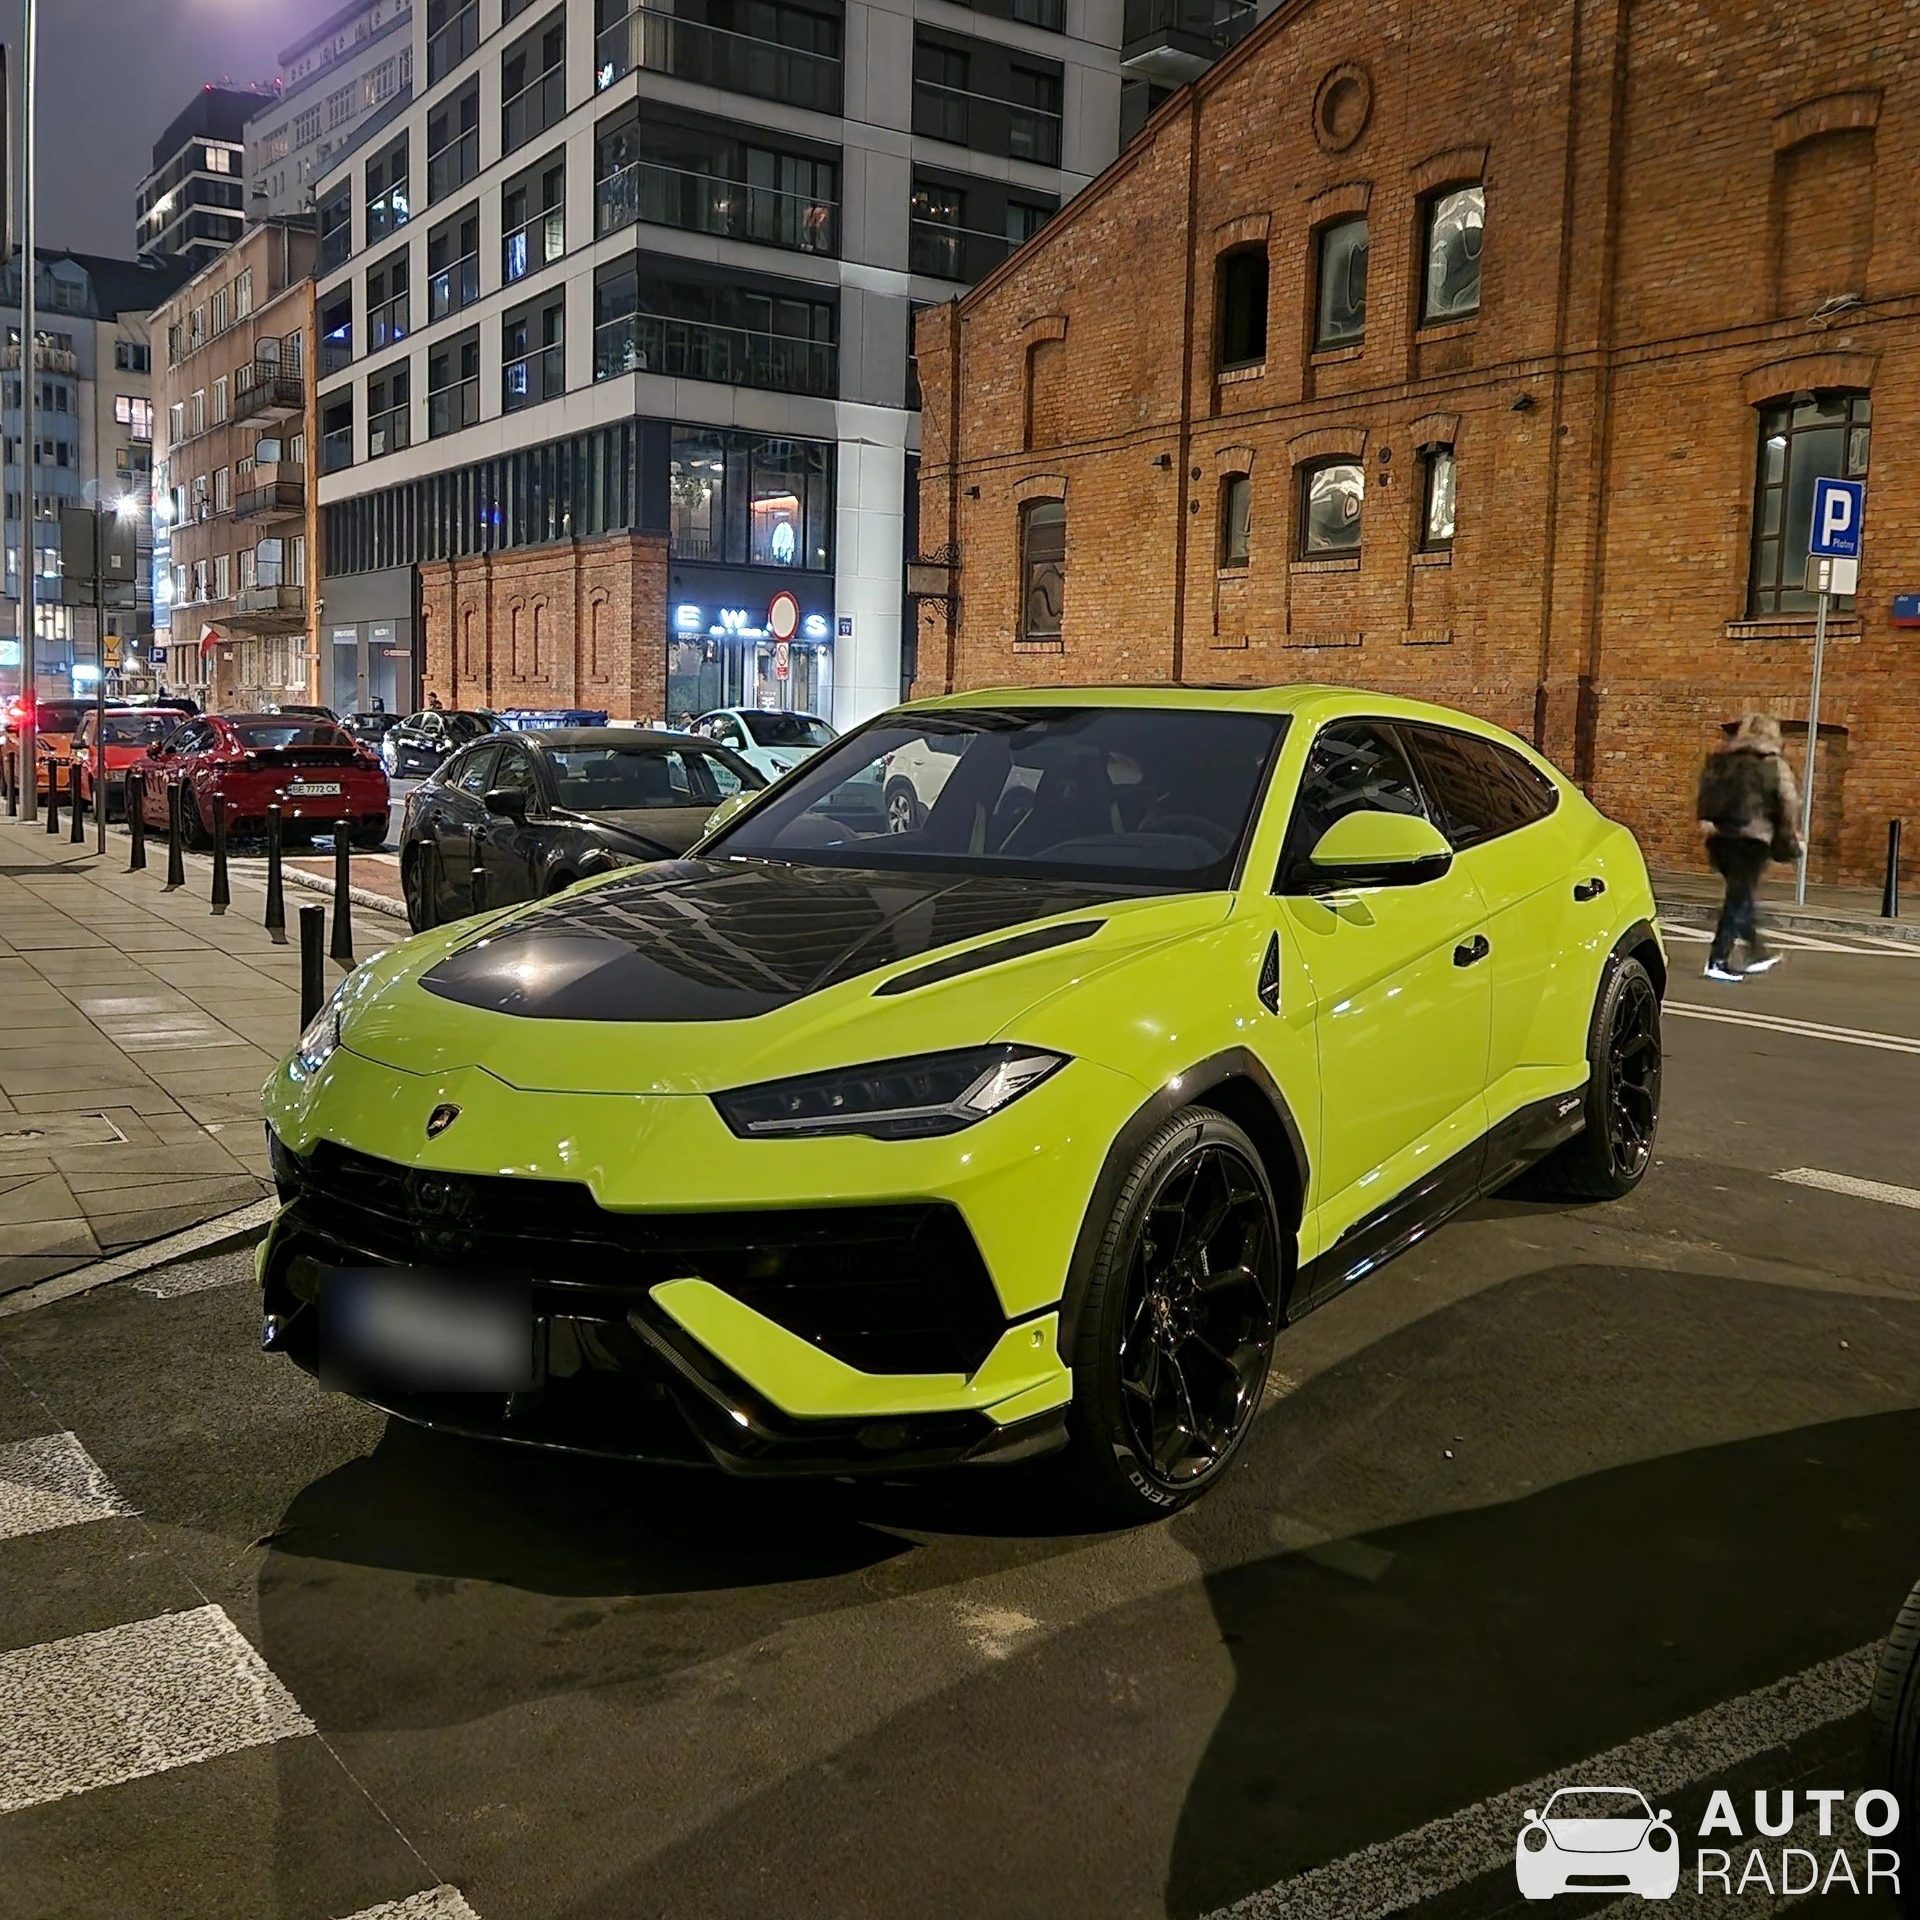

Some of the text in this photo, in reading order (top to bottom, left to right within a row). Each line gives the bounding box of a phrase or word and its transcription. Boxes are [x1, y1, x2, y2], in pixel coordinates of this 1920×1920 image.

[1821, 488, 1852, 547] P
[153, 649, 164, 662] P
[306, 785, 325, 793] 7772
[326, 785, 337, 793] CK
[1129, 1471, 1176, 1506] ZERO
